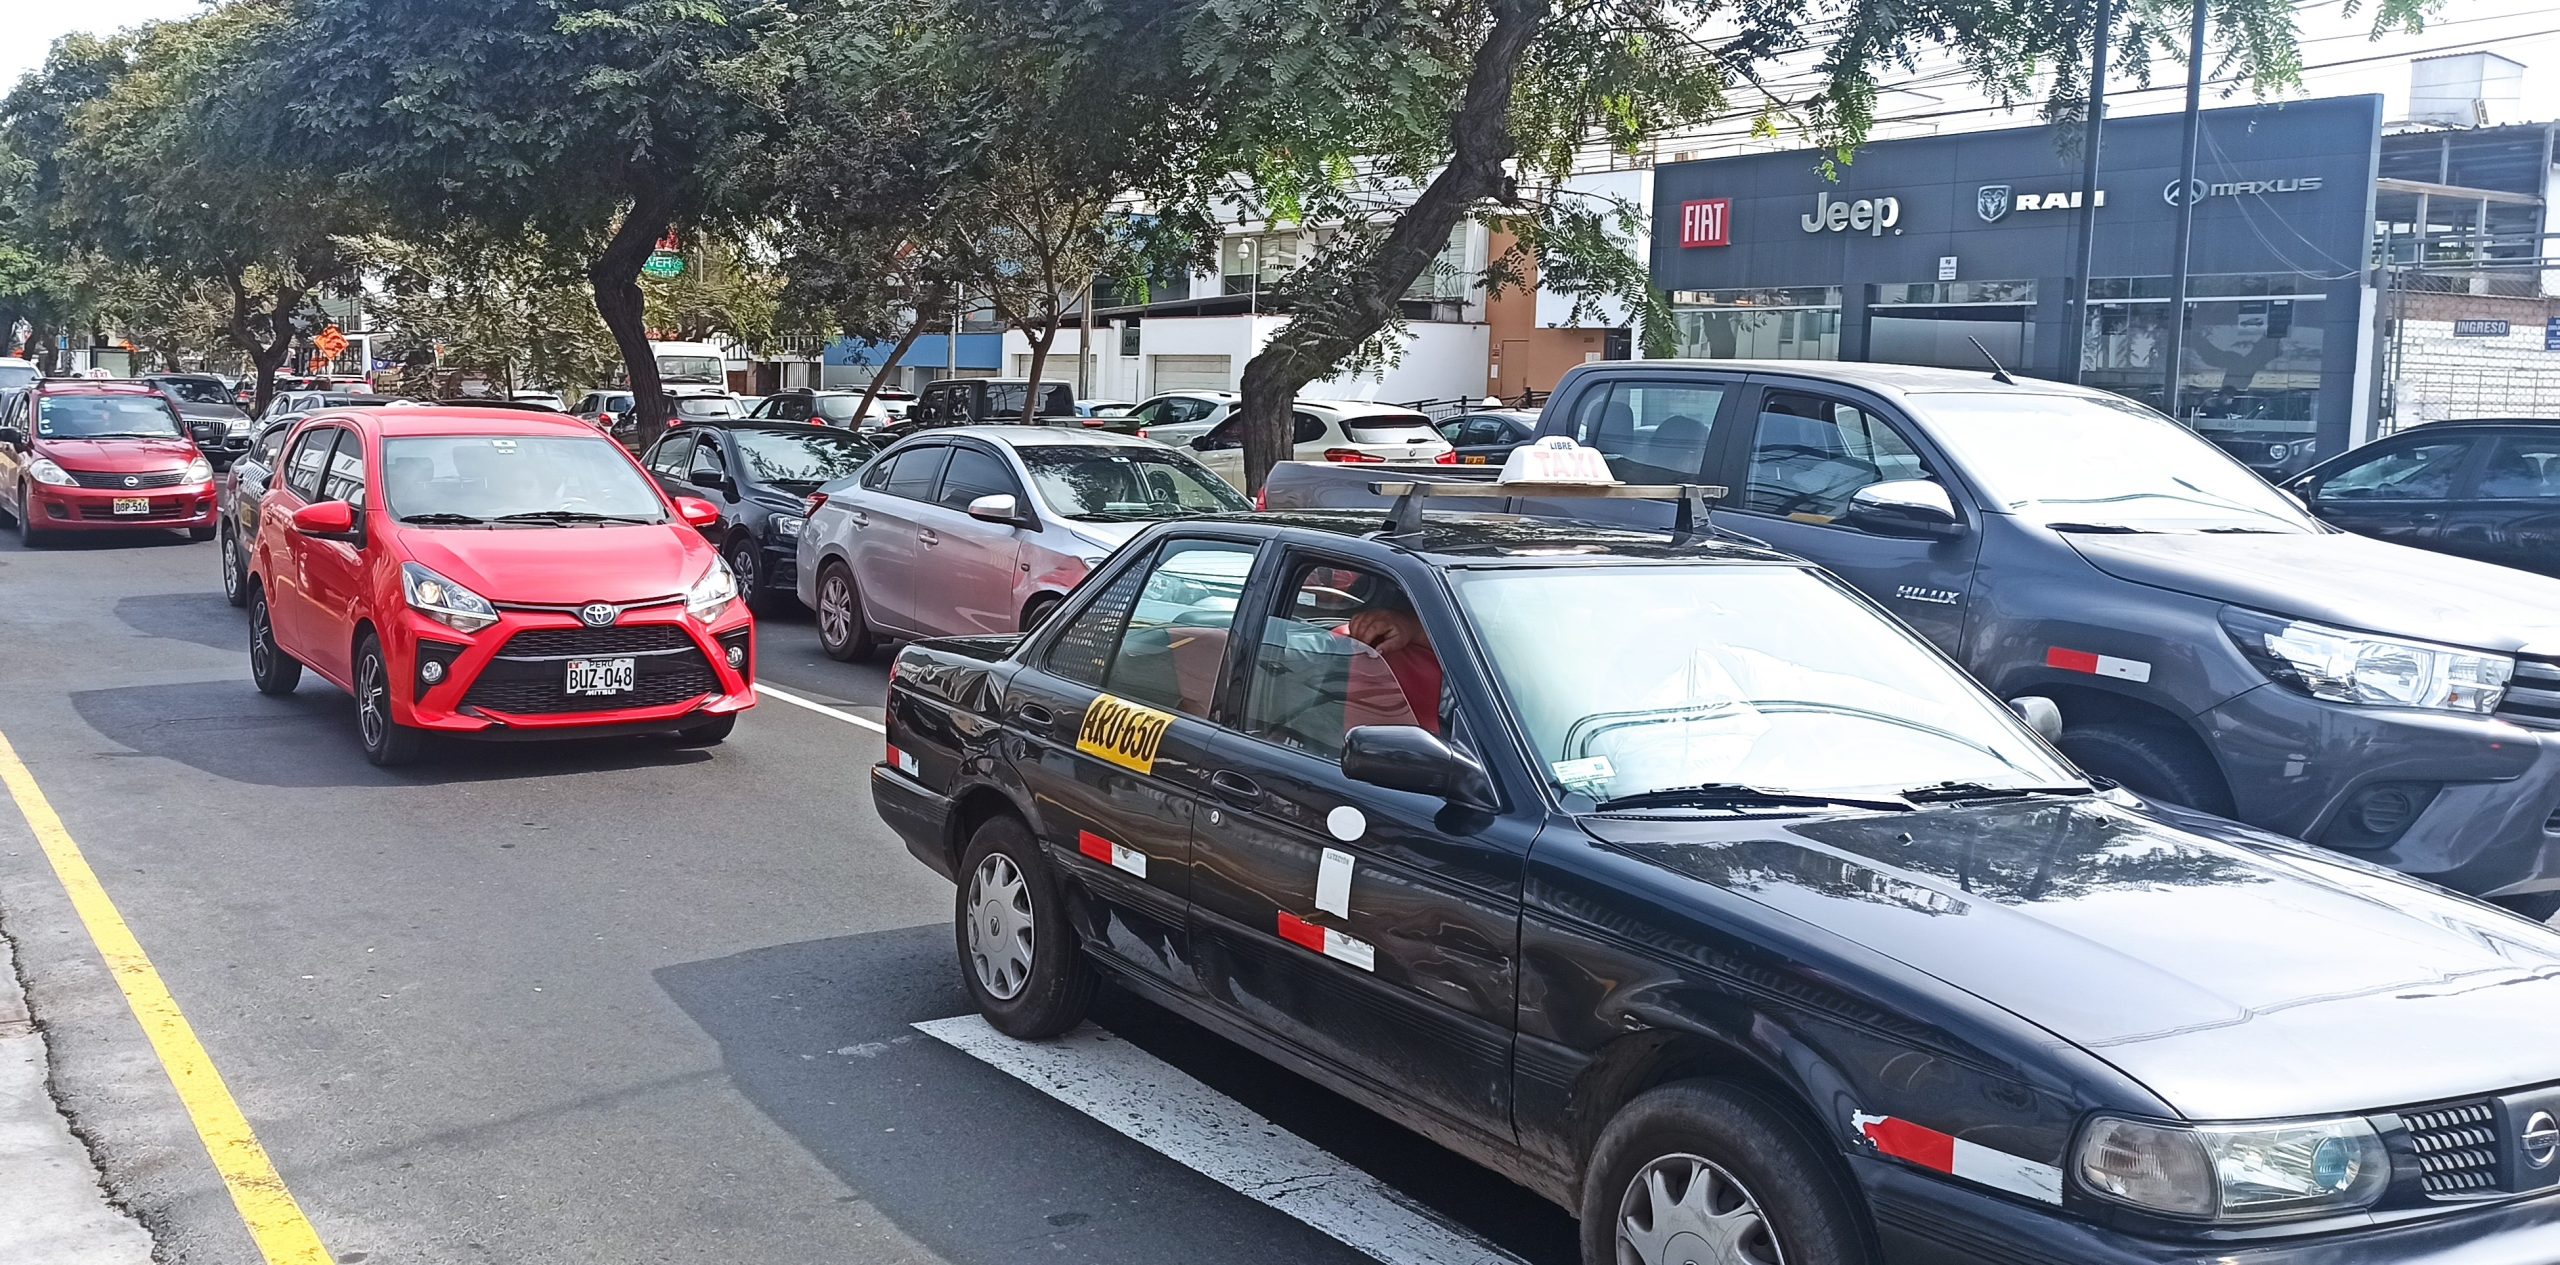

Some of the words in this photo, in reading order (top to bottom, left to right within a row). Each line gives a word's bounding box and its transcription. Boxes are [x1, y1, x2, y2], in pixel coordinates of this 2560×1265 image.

[2210, 177, 2323, 197] MAXUS
[1683, 202, 1725, 243] FIAT
[1801, 191, 1900, 237] Jeep
[2456, 321, 2506, 334] INGRESO
[1550, 441, 1573, 451] LIBRE
[1533, 451, 1599, 478] TAXI
[1895, 585, 1960, 605] HILUX
[569, 666, 633, 690] BUZ-048
